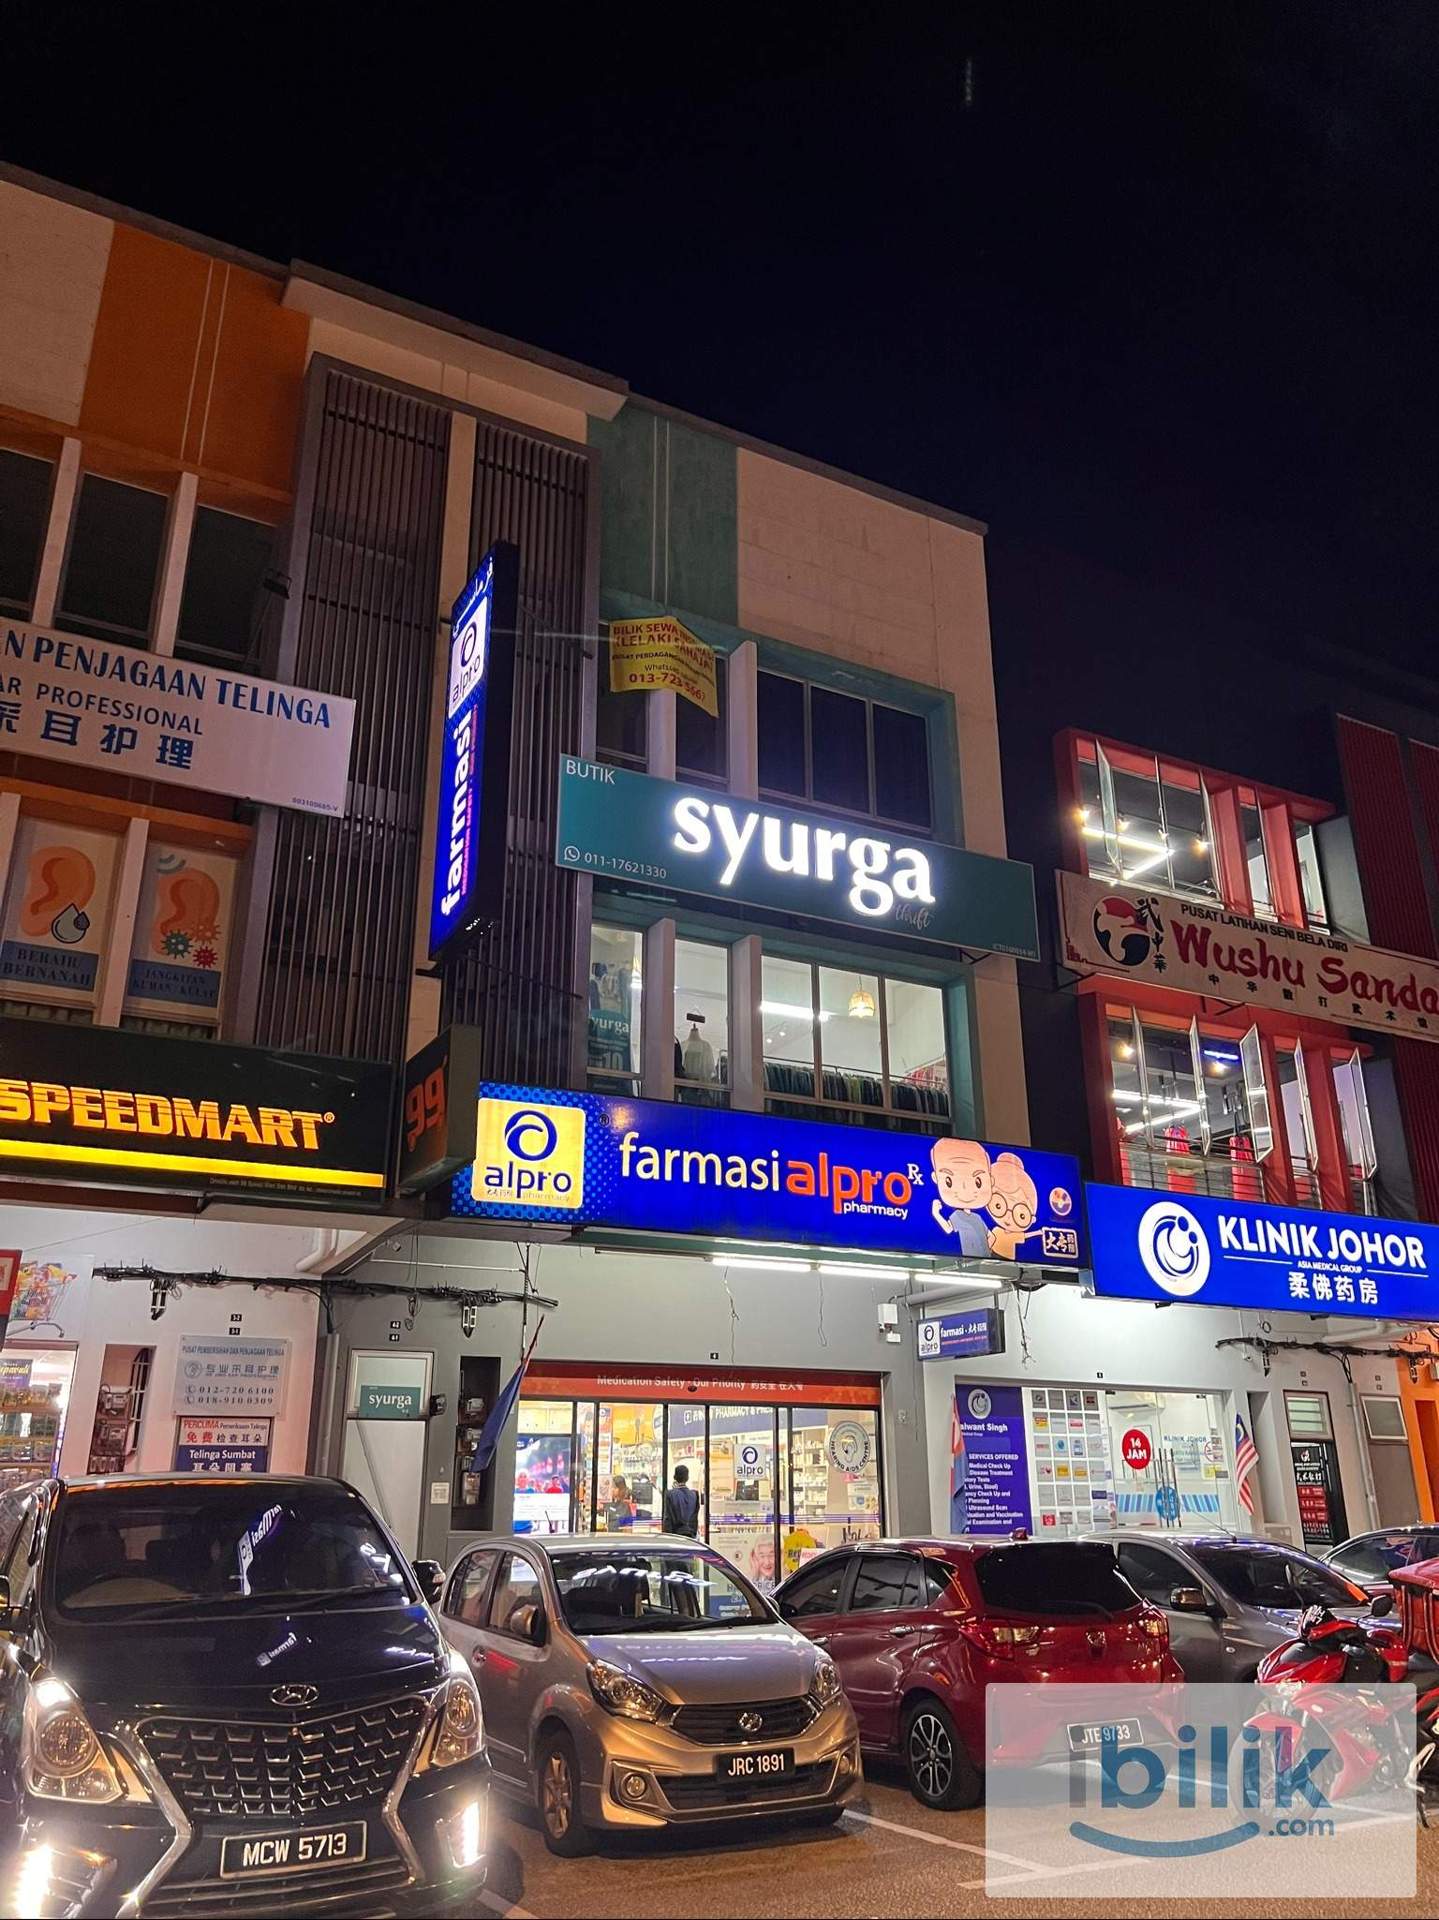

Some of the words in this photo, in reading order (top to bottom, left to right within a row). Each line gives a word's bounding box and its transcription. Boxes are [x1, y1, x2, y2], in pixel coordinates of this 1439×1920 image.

[646, 623, 678, 634] SEWA
[32, 636, 207, 701] PENJAGAAN
[215, 678, 331, 729] TELINGA
[36, 683, 203, 735] PROFESSIONAL
[566, 759, 616, 785] BUTIK
[441, 710, 472, 916] farmasi
[584, 852, 667, 879] 011-17621330
[673, 797, 936, 917] syurga
[1181, 903, 1219, 924] PUSAT
[1220, 914, 1268, 934] LATIHAN
[1270, 924, 1296, 940] SENI
[1297, 933, 1326, 948] BELA
[1327, 940, 1349, 953] DIRI
[1169, 919, 1306, 989] Wushu
[1316, 956, 1439, 1016] Sanda
[590, 1015, 630, 1035] yurga
[0, 1077, 323, 1151] SPEEDMART
[484, 1161, 572, 1199] alpro
[619, 1131, 780, 1191] farmasi
[786, 1151, 912, 1214] alpro
[843, 1199, 909, 1221] pharmacy
[1217, 1215, 1323, 1258] KLINIK
[1327, 1227, 1427, 1270] JOHOR
[1313, 1263, 1340, 1273] MEDICAL
[1340, 1265, 1363, 1274] GROUP
[1288, 1271, 1379, 1305] 柔佛药房
[940, 1325, 965, 1338] farmasi
[597, 1375, 652, 1387] Medication
[654, 1376, 685, 1389] Safety
[693, 1378, 709, 1387] Our
[712, 1379, 746, 1391] Priority
[368, 1393, 412, 1409] syurga
[183, 1419, 220, 1429] PERCUMA
[986, 1423, 1008, 1433] Singh
[189, 1449, 221, 1461] Telinga
[222, 1449, 256, 1459] Sumbat
[968, 1453, 994, 1461] SERVICES
[1126, 1449, 1147, 1460] JAM
[736, 1465, 764, 1476] alpro
[1081, 1727, 1103, 1744] JTE
[1102, 1724, 1131, 1742] 9733
[727, 1755, 754, 1777] JRC
[755, 1751, 786, 1773] 1891
[242, 1837, 290, 1867] MCW
[298, 1832, 347, 1860] 5713
